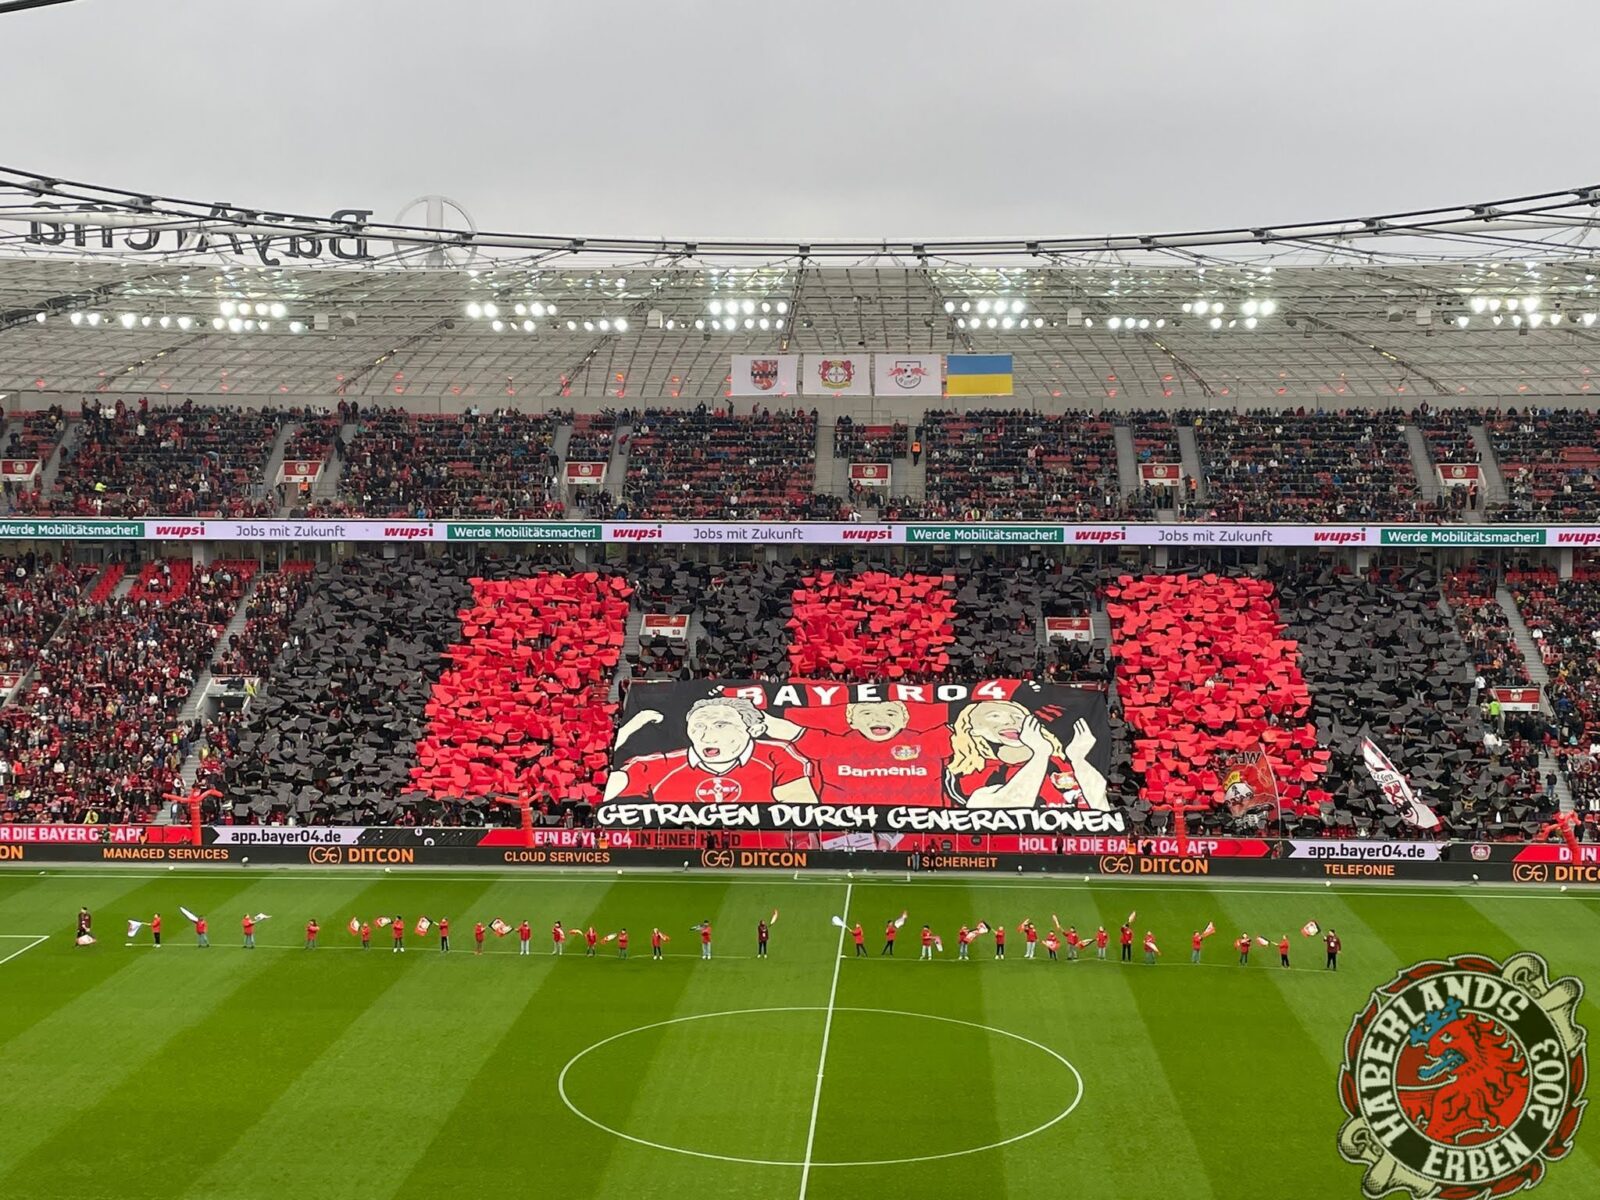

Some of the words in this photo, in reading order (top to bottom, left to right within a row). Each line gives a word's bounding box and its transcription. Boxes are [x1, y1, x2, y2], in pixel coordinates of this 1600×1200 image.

[0, 525, 37, 536] Werde
[39, 525, 139, 538] Mobilitätsmacher!
[156, 521, 205, 538] wupsi
[237, 525, 265, 536] Jobs
[270, 525, 291, 536] mit
[295, 525, 346, 537] Zukunft
[384, 522, 434, 539] wupsi
[454, 527, 491, 537] Werde
[495, 527, 596, 539] Mobilitätsmacher!
[613, 523, 662, 540] wupsi
[694, 527, 722, 539] Jobs
[727, 527, 747, 539] mit
[752, 527, 804, 539] Zukunft
[842, 524, 892, 541] wupsi
[914, 529, 950, 539] Werde
[955, 528, 1058, 541] Mobilitätsmacher!
[1075, 525, 1126, 543] wupsi
[1159, 529, 1188, 542] Jobs
[1194, 530, 1214, 542] mit
[1219, 529, 1273, 543] Zukunft
[1314, 526, 1366, 544] wupsi
[1388, 531, 1428, 542] Werde
[1432, 530, 1540, 544] Mobilitätsmacher!
[838, 764, 928, 778] Barmenia
[597, 804, 762, 826] GETRAGEN
[768, 804, 878, 827] DURCH
[886, 806, 1125, 832] GENERATIONEN
[13, 828, 36, 841] DIE
[39, 828, 87, 841] BAYER
[232, 829, 341, 846] app.bayer04.de
[535, 832, 559, 845] EIN
[613, 832, 633, 845] 04
[1020, 838, 1049, 851] HOL
[1080, 839, 1104, 852] DIE
[1160, 840, 1179, 853] 04
[1308, 844, 1425, 860] app.bayer04.de
[104, 848, 165, 859] MANAGED
[169, 848, 229, 859] SERVICES
[348, 848, 414, 862] DITCON
[505, 852, 546, 862] CLOUD
[550, 852, 610, 862] SERVICES
[741, 852, 807, 867] DITCON
[923, 857, 997, 868] SICHERHEIT
[1140, 858, 1208, 874] DITCON
[1324, 864, 1395, 876] TELEFONIE
[1555, 866, 1600, 881] DITC
